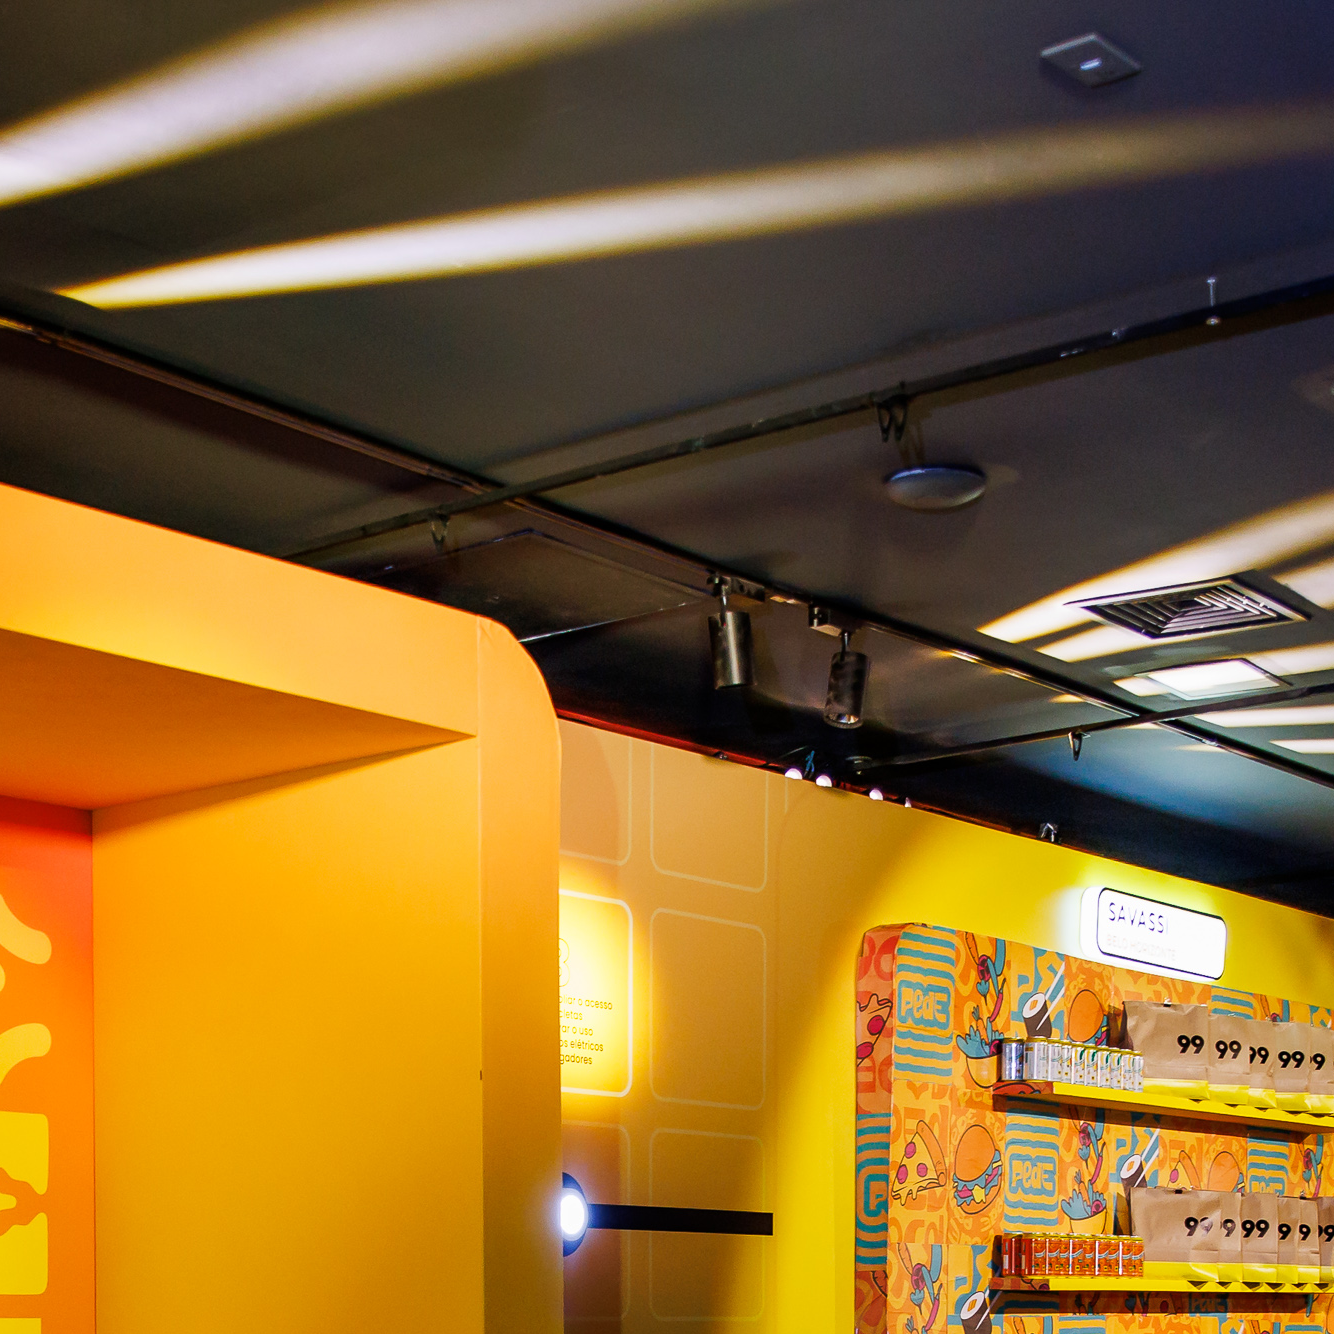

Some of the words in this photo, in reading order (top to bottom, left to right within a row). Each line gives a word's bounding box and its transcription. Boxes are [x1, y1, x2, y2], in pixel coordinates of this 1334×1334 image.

[585, 999, 613, 1010] acesso
[579, 1027, 594, 1036] uso
[570, 1039, 604, 1051] elétricos
[1177, 1035, 1204, 1054] 99
[1215, 1040, 1242, 1059] 99
[1278, 1051, 1305, 1068] 99
[1310, 1053, 1326, 1070] 9
[1184, 1216, 1213, 1237] 99
[1220, 1218, 1236, 1237] 9
[1241, 1219, 1269, 1238] 99
